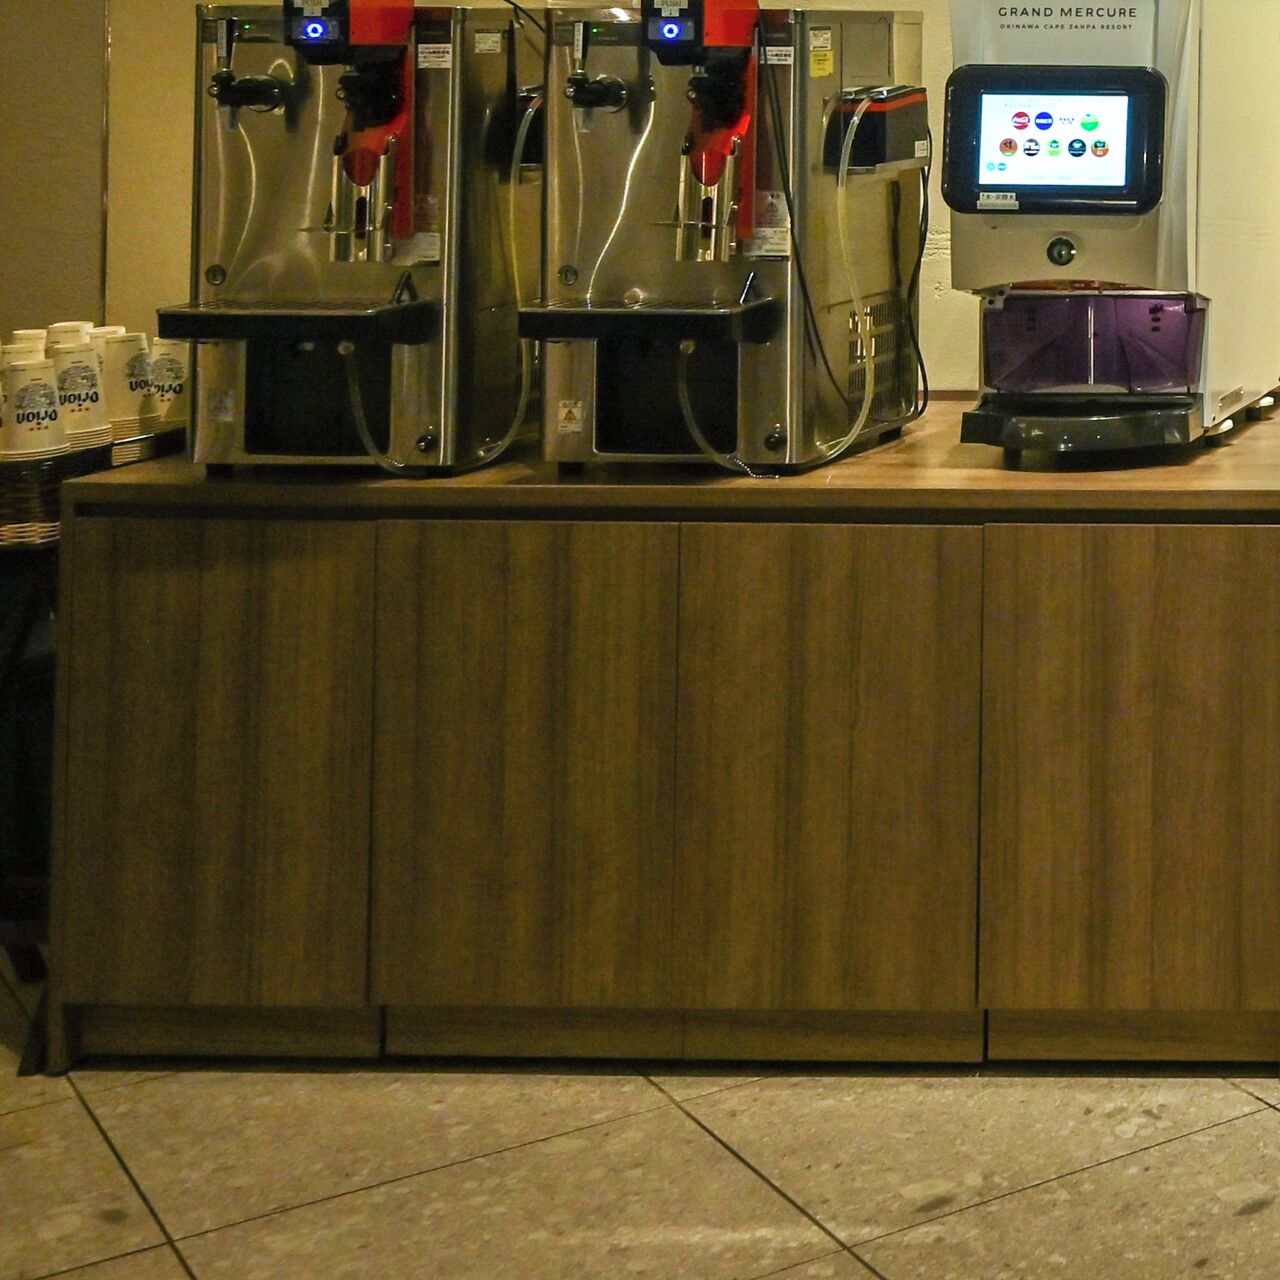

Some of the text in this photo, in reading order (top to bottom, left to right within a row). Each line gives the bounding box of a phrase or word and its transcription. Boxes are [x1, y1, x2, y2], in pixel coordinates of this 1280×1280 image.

[998, 7, 1137, 17] GRAND MERCURE
[58, 391, 99, 407] Orion
[16, 409, 58, 426] Orion
